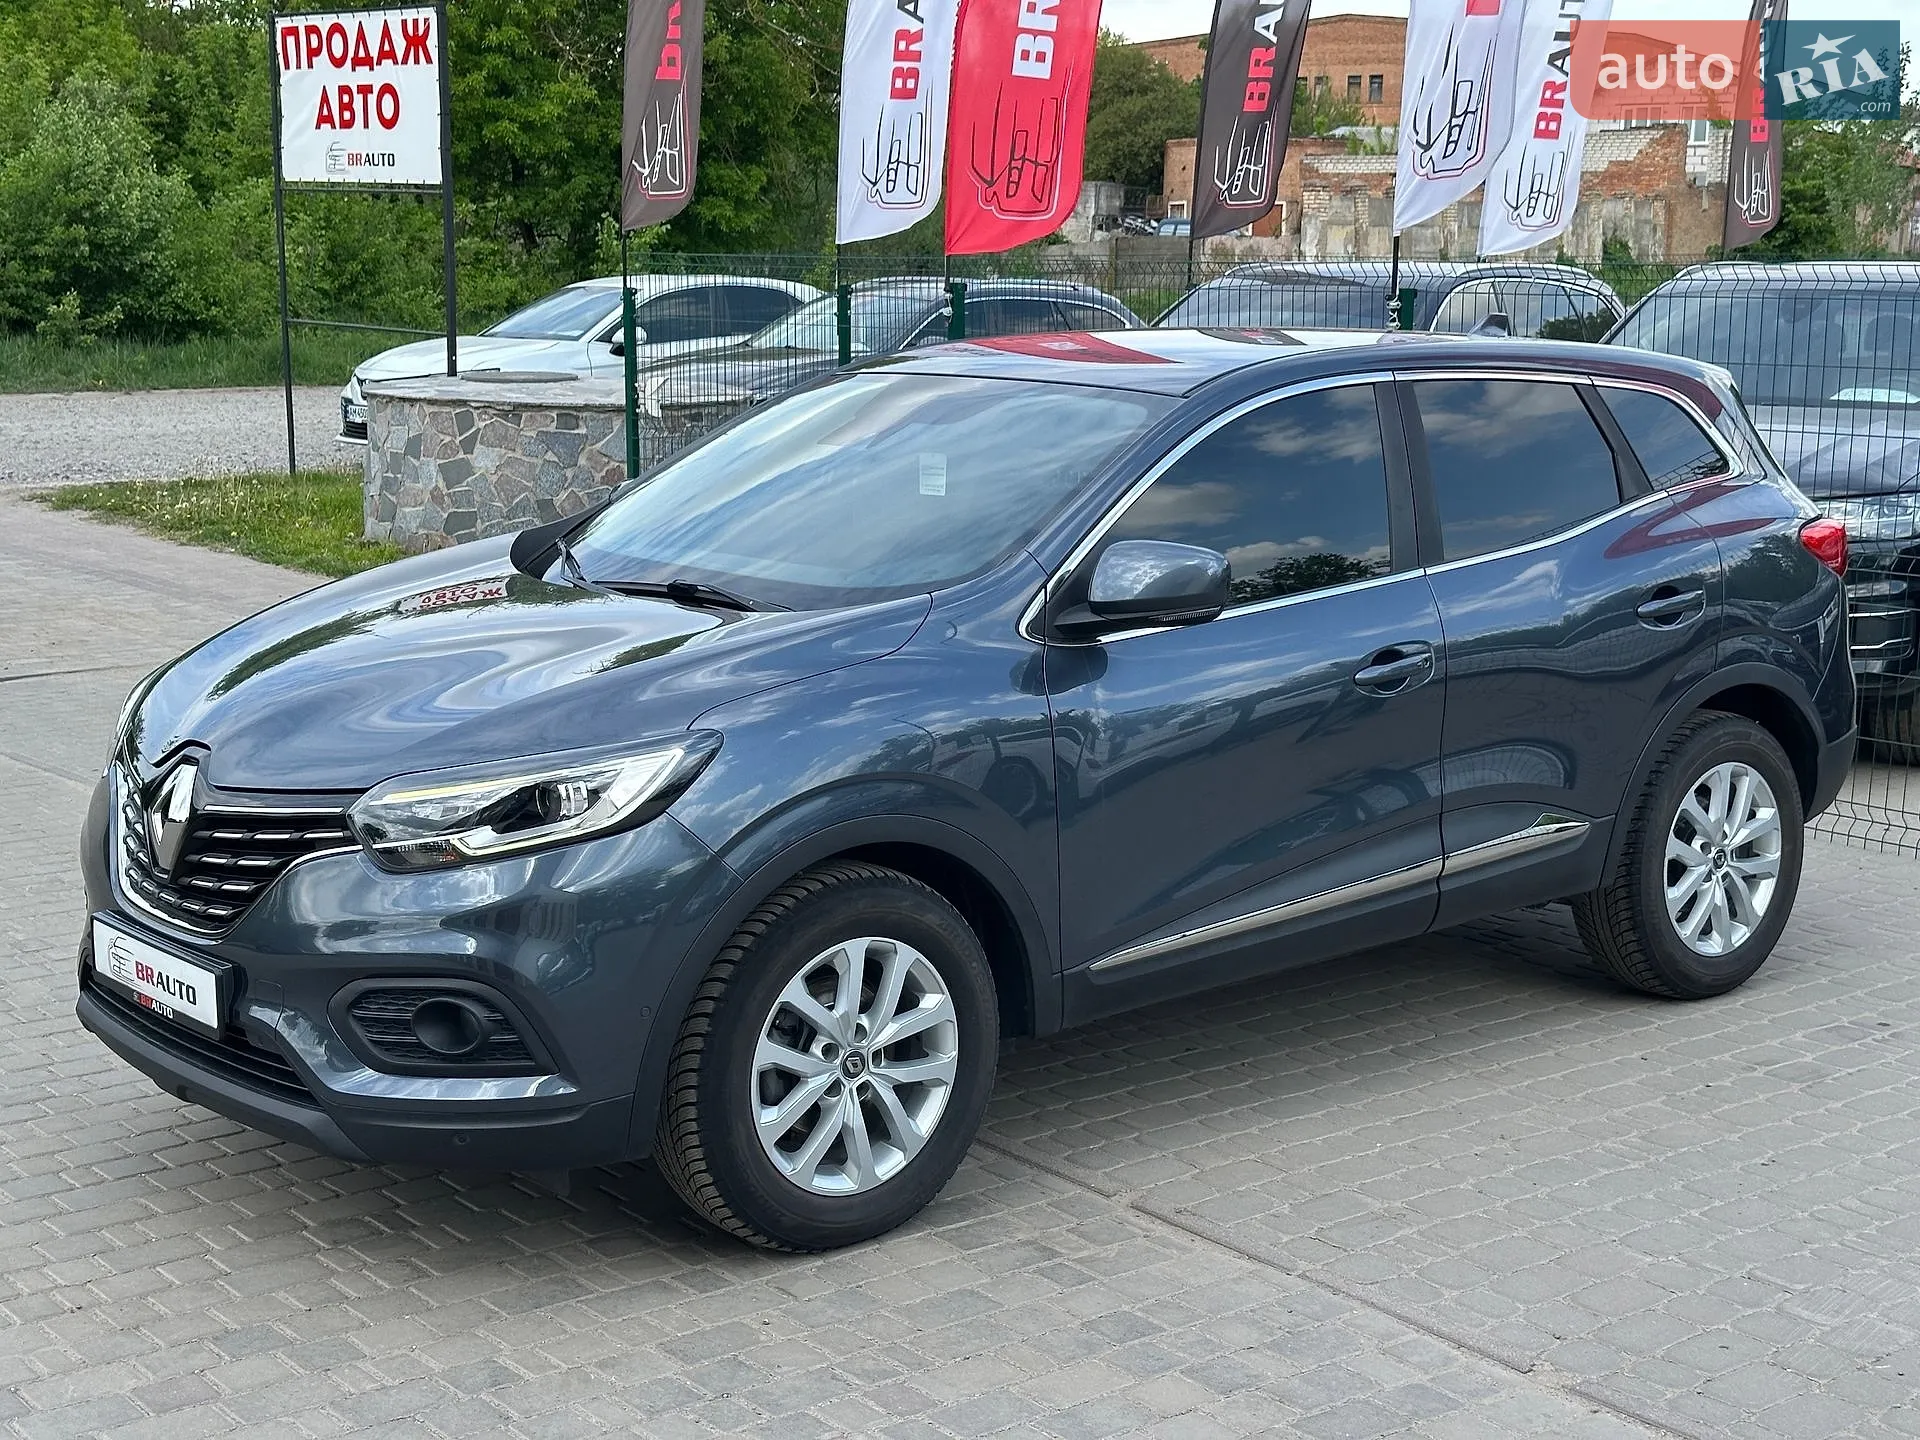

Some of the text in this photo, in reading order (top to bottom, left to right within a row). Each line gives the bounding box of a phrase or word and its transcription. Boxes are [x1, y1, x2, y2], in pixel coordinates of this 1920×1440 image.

[280, 18, 433, 72] ПРОДАЖ
[1242, 0, 1285, 112] BRA
[315, 82, 400, 130] АВТО
[347, 152, 395, 167] BRAUTO
[134, 960, 197, 1006] BRAUTO
[138, 992, 174, 1019] BRAUTO
